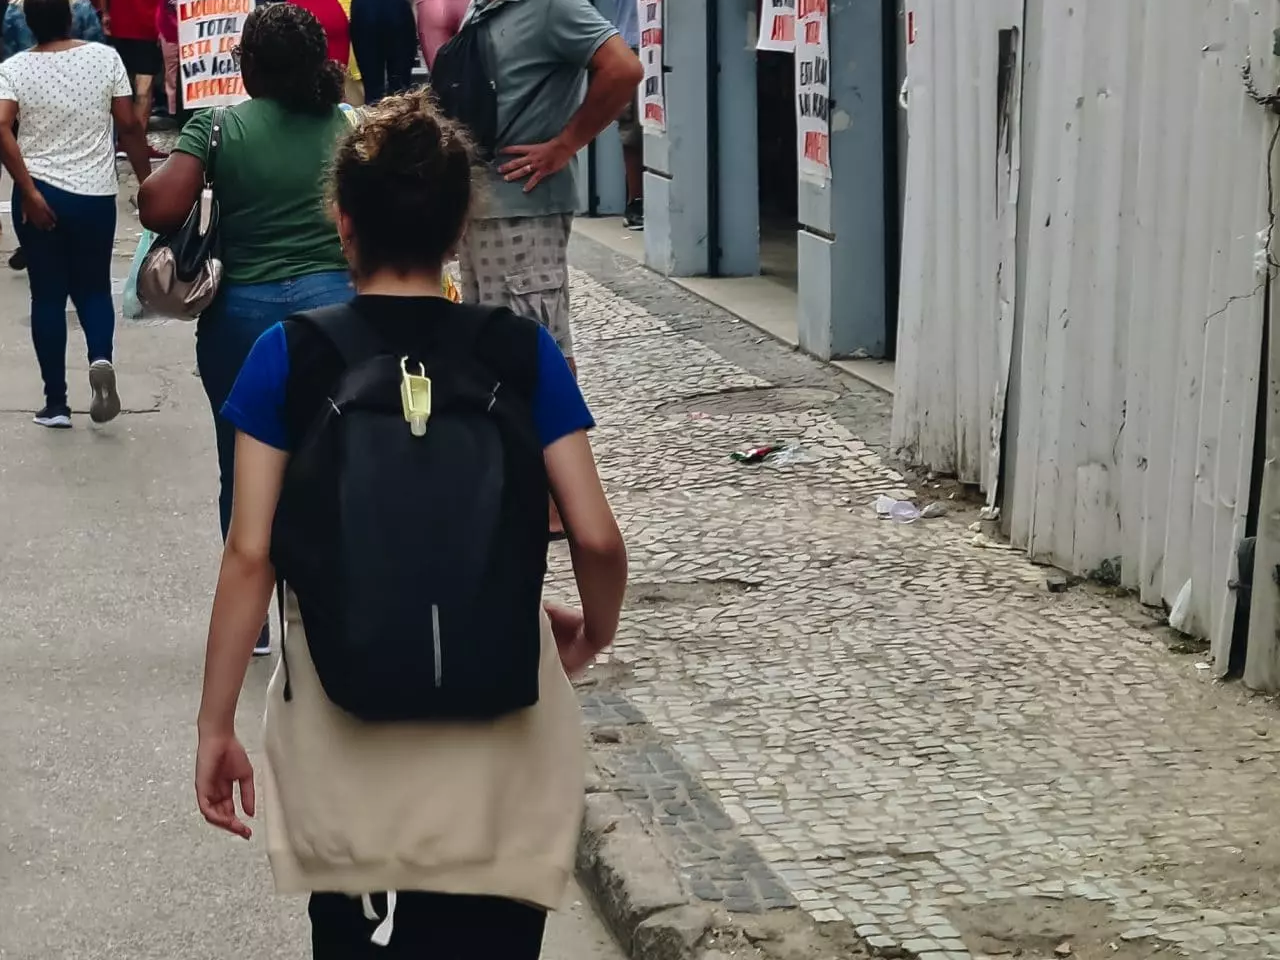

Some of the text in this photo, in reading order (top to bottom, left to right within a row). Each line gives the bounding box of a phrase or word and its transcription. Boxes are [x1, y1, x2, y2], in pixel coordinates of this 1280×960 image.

[196, 17, 240, 38] TOTAL
[181, 37, 235, 59] ESTA LO
[212, 56, 241, 76] ACAB
